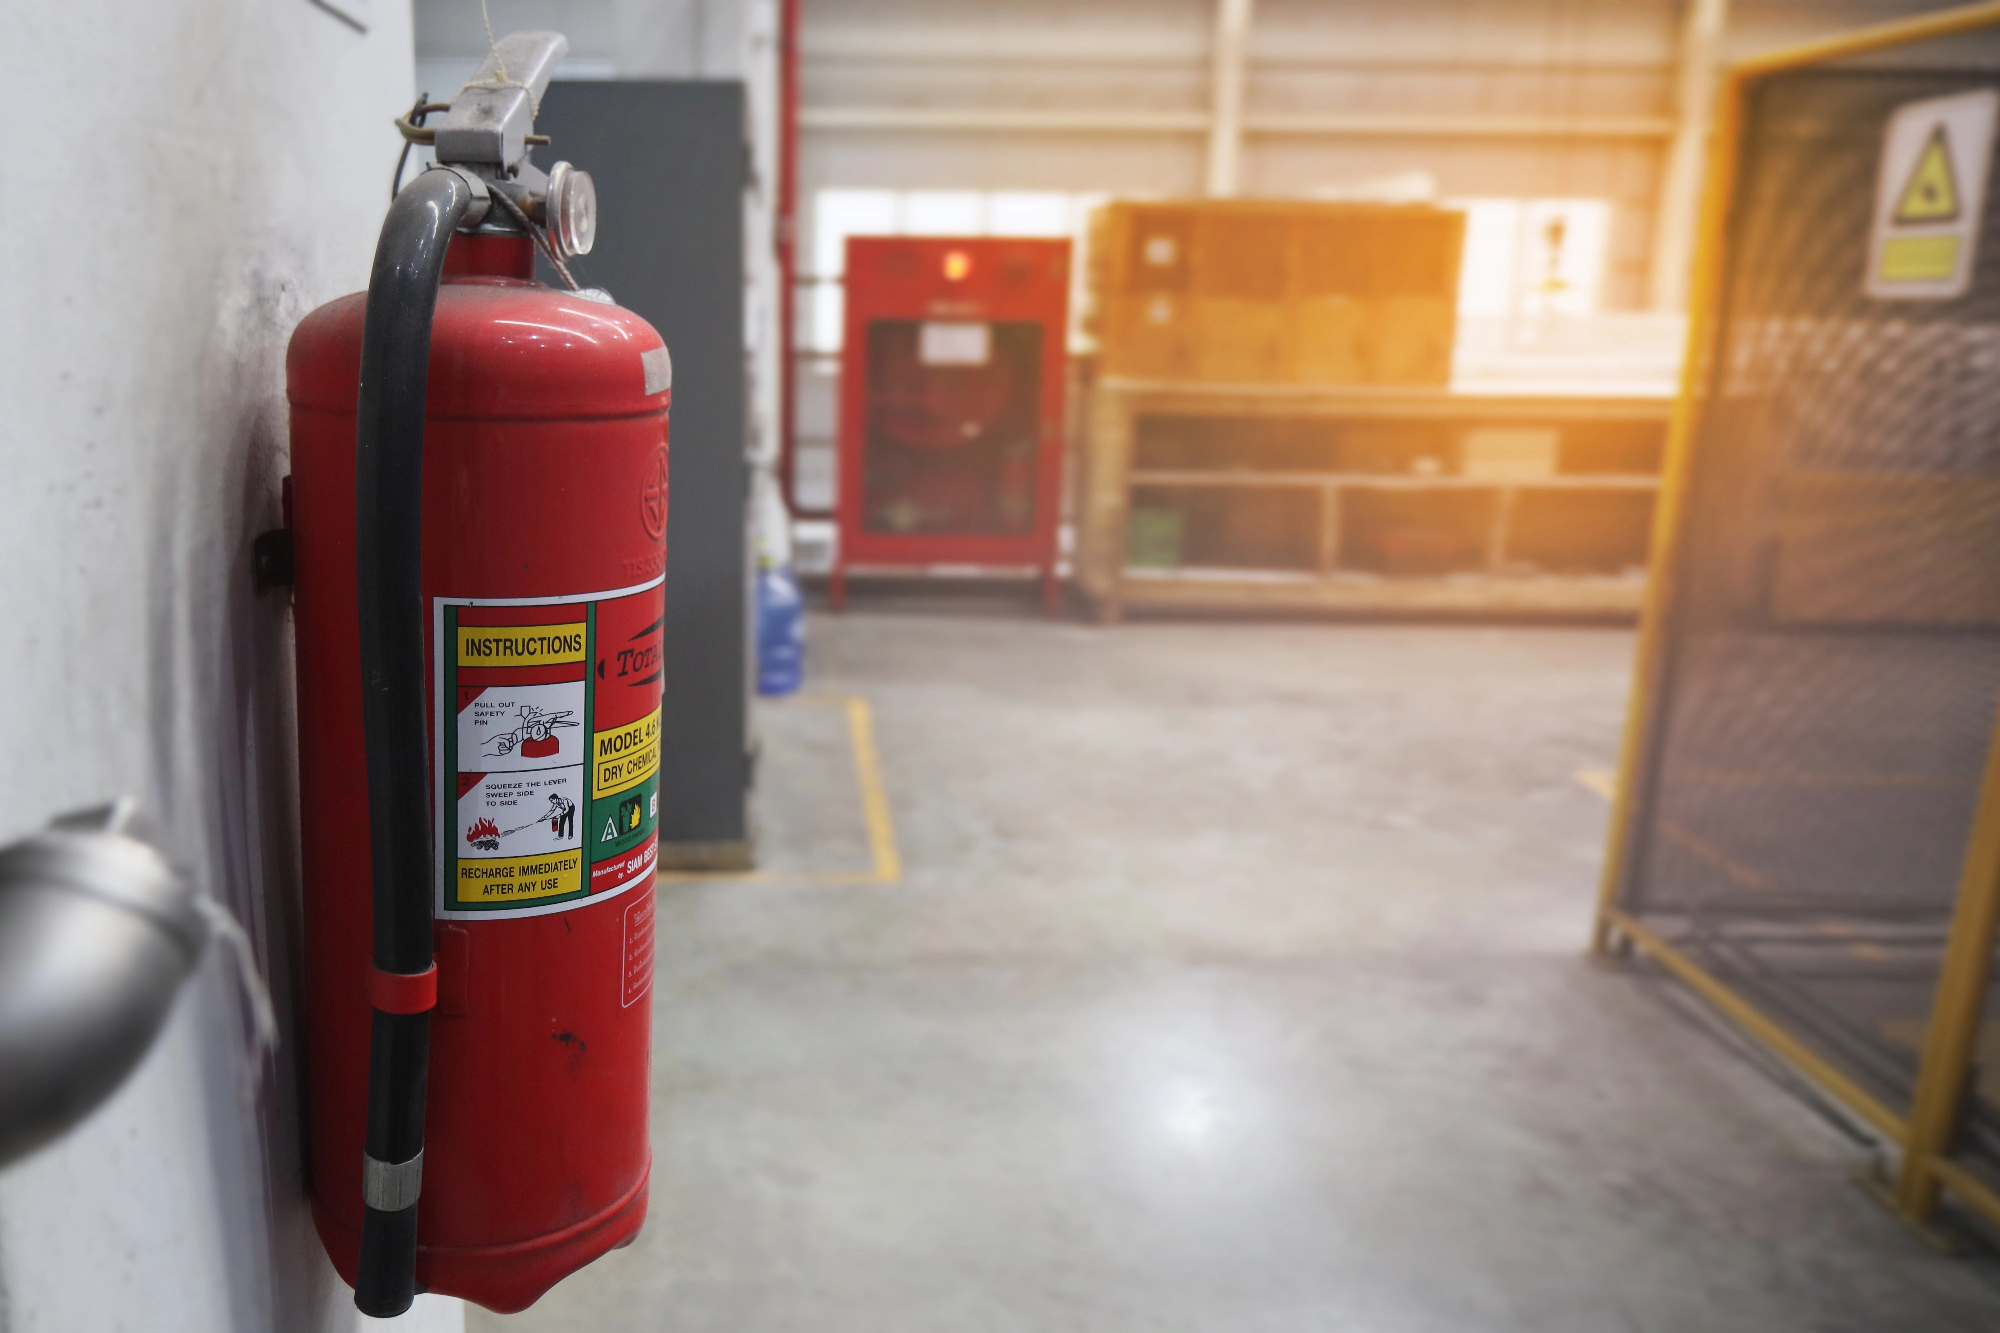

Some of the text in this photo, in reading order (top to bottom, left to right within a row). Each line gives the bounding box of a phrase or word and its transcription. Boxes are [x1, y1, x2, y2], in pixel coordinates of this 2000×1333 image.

[465, 634, 582, 657] INSTRUCTIONS
[599, 727, 644, 757] MODEL
[603, 763, 624, 783] DRY
[627, 746, 657, 775] CHEMICAL
[462, 776, 470, 786] 2
[485, 782, 523, 790] SQUEEZE
[543, 778, 567, 786] LEVER
[485, 791, 513, 799] SWEEP
[461, 858, 579, 879] RECHARGE IMMEDIATELY
[626, 853, 643, 875] SIAM
[482, 877, 559, 896] AFTER ANY USE
